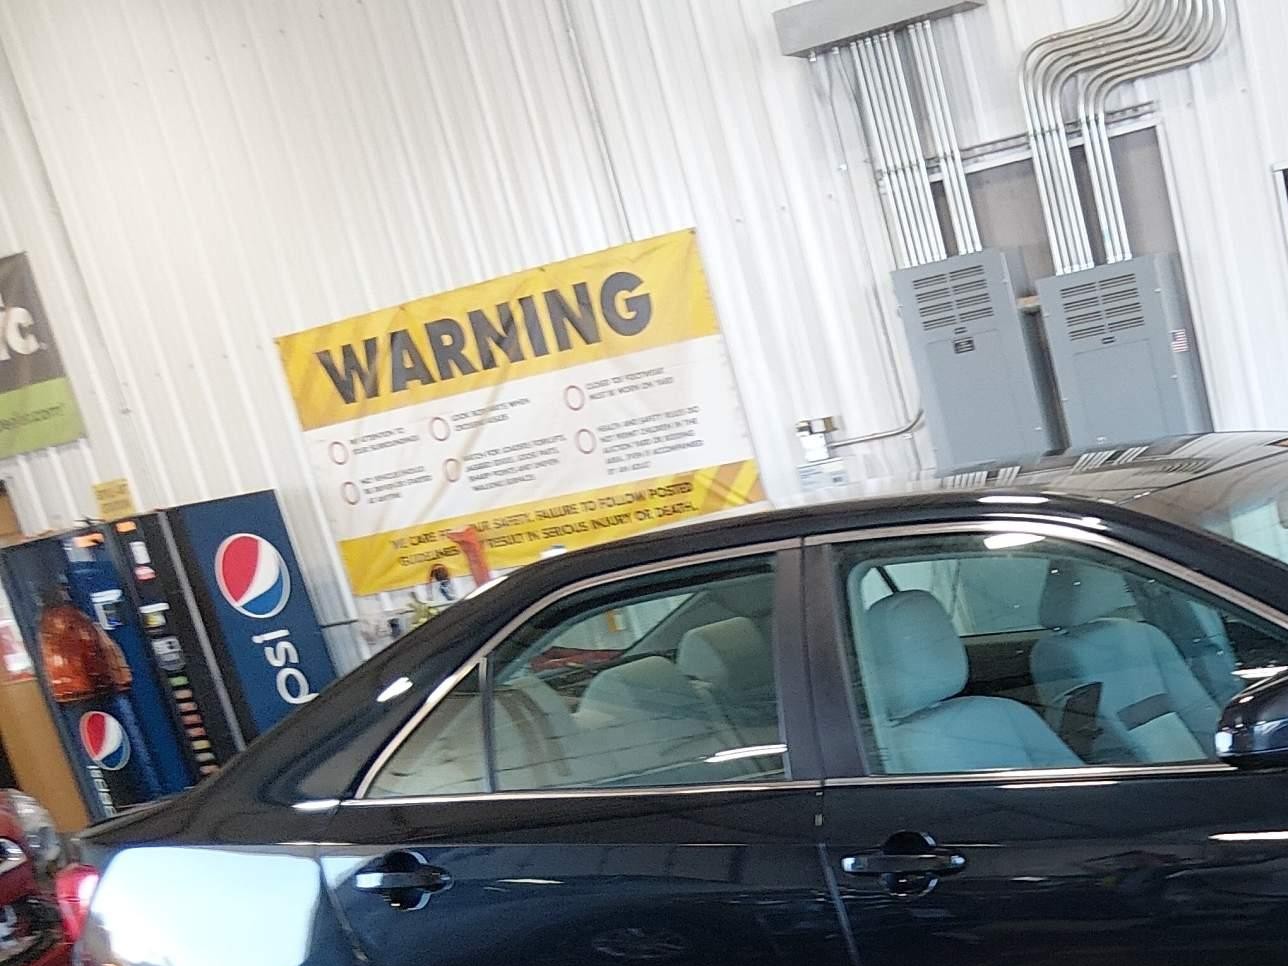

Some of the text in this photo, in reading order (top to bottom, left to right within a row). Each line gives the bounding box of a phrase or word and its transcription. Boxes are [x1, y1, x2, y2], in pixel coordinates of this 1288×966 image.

[315, 271, 652, 405] WARNING
[534, 503, 578, 520] FAILURE
[579, 500, 596, 511] TO
[598, 490, 645, 508] FOLLOW
[648, 481, 694, 499] POSTED
[541, 520, 588, 538] SERIOUS
[591, 512, 634, 529] INJURY
[655, 499, 699, 517] DEATH.
[252, 629, 320, 705] psi
